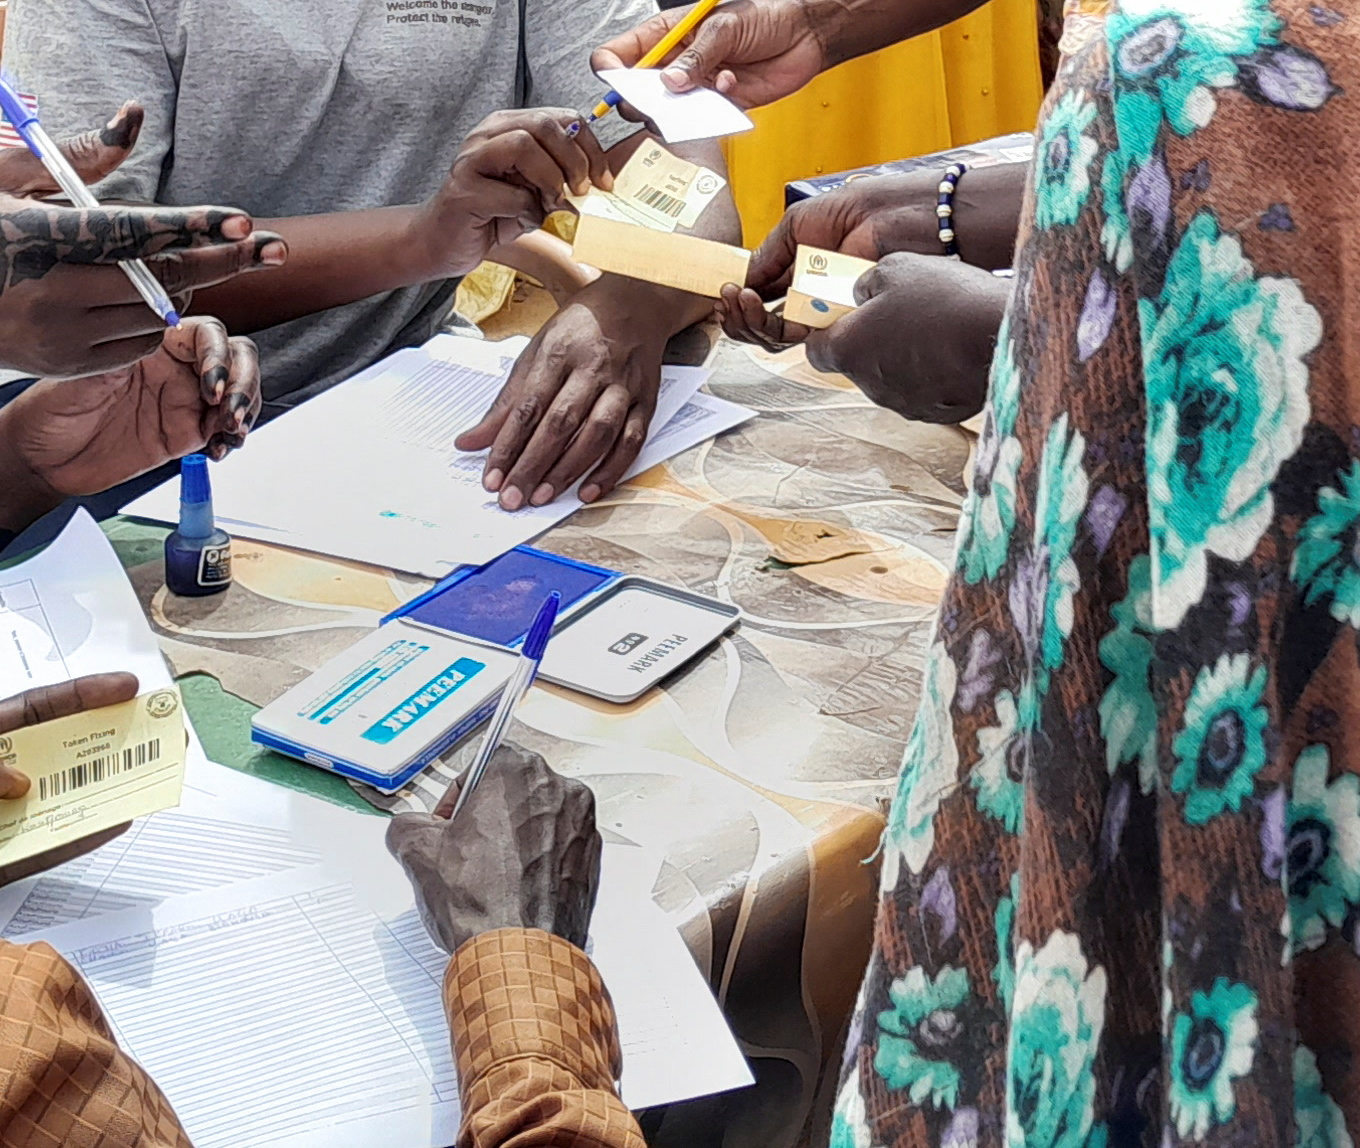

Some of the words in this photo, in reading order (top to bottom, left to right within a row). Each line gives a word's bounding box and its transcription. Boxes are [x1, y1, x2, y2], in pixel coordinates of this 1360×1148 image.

[386, 0, 439, 12] Welcome
[441, 0, 458, 10] the
[386, 13, 429, 24] Protect
[432, 14, 448, 24] the
[627, 633, 688, 674] PEEMARK
[380, 668, 467, 733] PEEMARK
